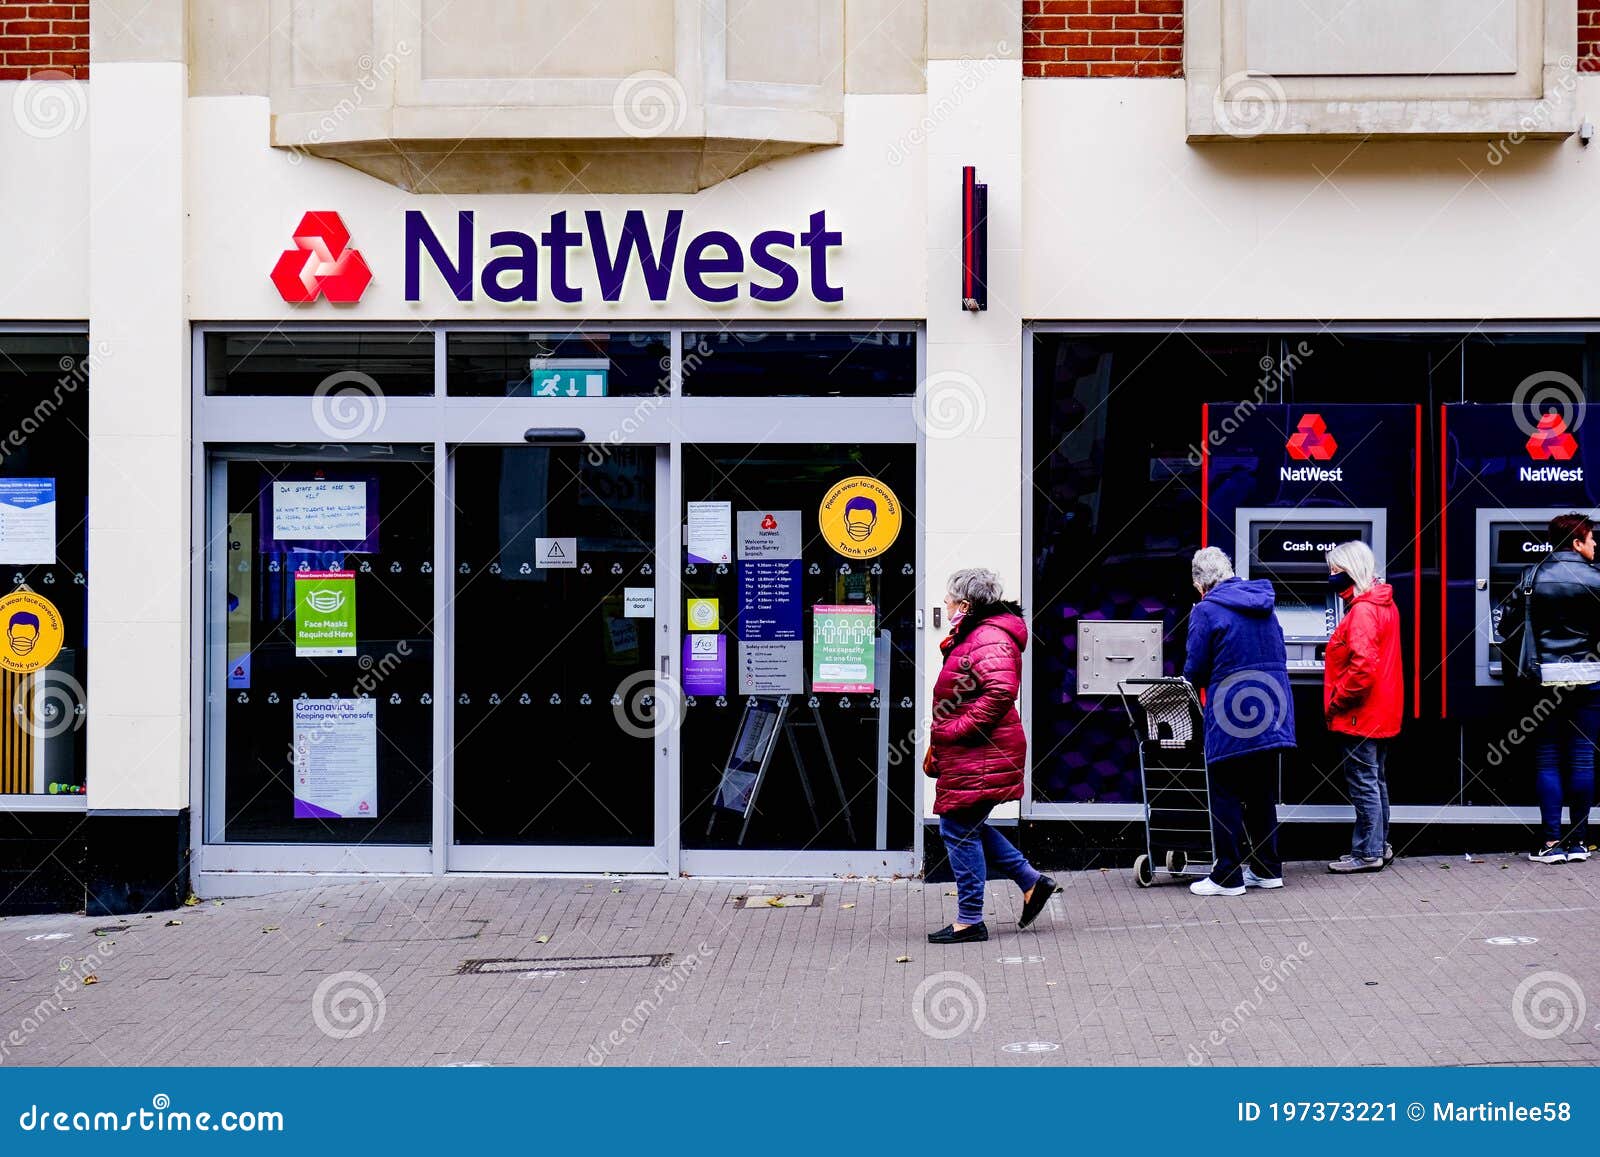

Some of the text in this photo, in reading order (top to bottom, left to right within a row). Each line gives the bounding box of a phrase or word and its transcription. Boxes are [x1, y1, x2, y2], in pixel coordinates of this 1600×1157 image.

[404, 210, 843, 302] NatWest
[1280, 467, 1342, 482] NatWest
[1520, 467, 1583, 482] NatWest
[826, 481, 895, 515] Please wear face coverings
[840, 542, 877, 555] Thank you
[1283, 541, 1336, 551] Cash out
[1522, 541, 1553, 552] Cash
[7, 597, 23, 606] wear
[39, 602, 57, 630] coverings
[300, 631, 334, 639] Required
[3, 656, 23, 668] Thank
[296, 703, 354, 711] Coronavirus
